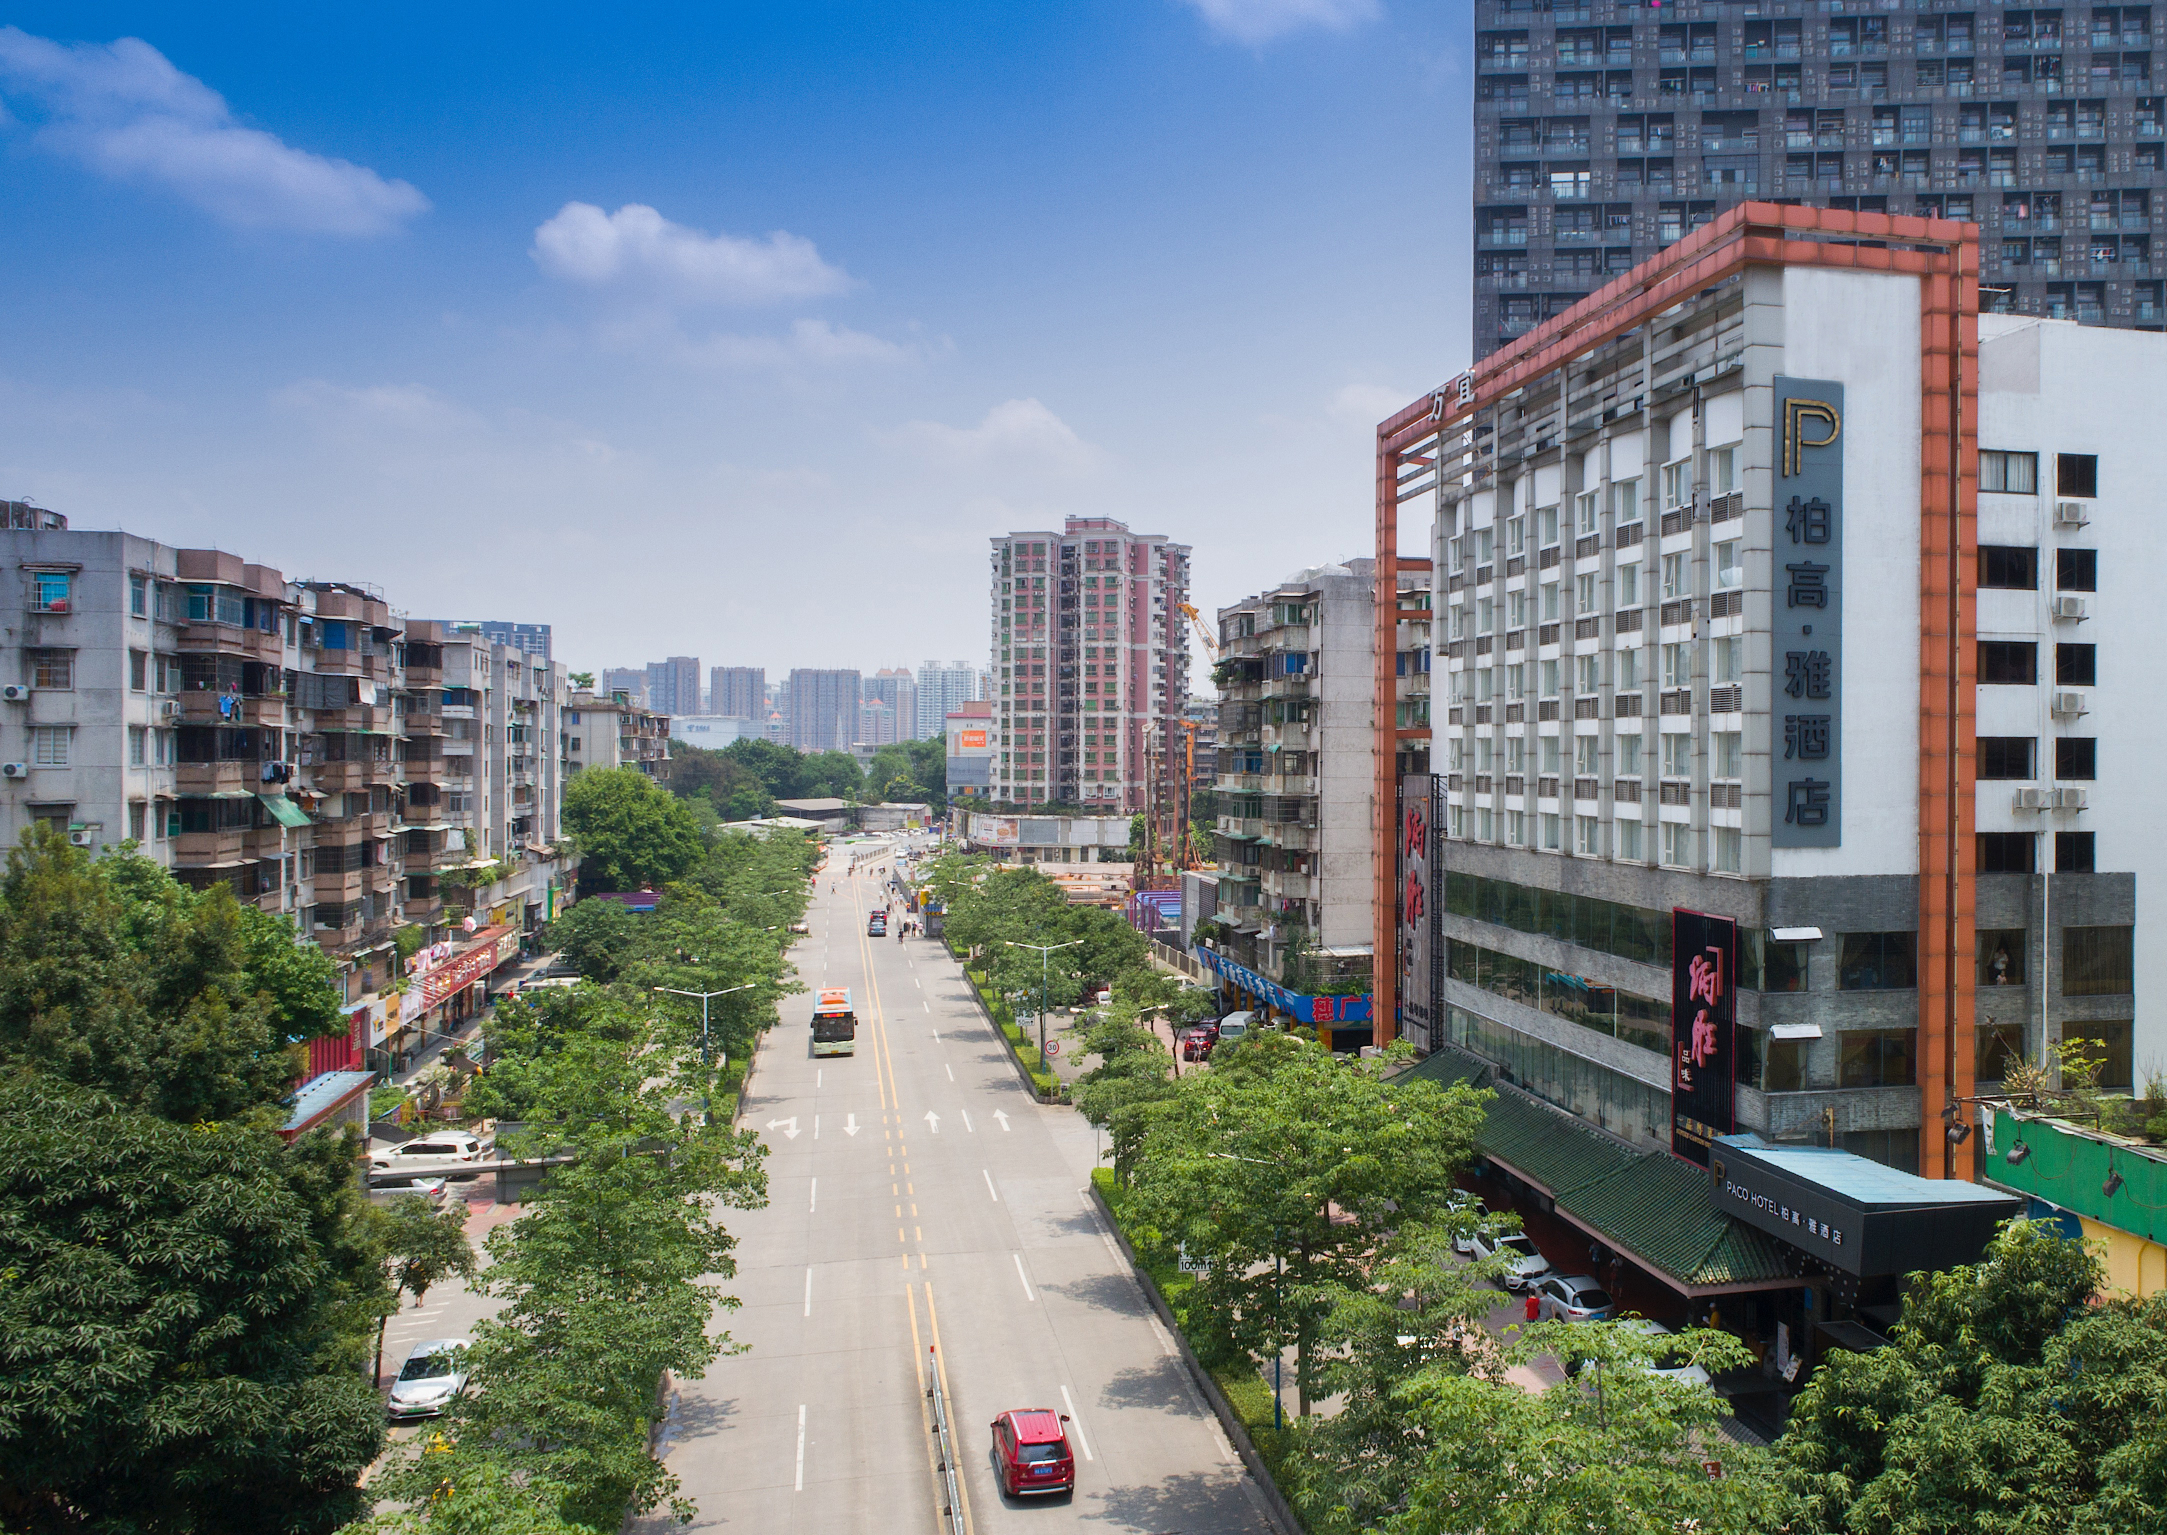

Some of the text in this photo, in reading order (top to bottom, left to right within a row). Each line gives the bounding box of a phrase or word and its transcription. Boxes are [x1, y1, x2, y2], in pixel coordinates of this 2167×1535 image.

[1785, 495, 1831, 826] 柏高·雅酒店
[1726, 1181, 1779, 1216] PACO HOTEL
[1781, 1204, 1842, 1245] 柏高·雅酒店
